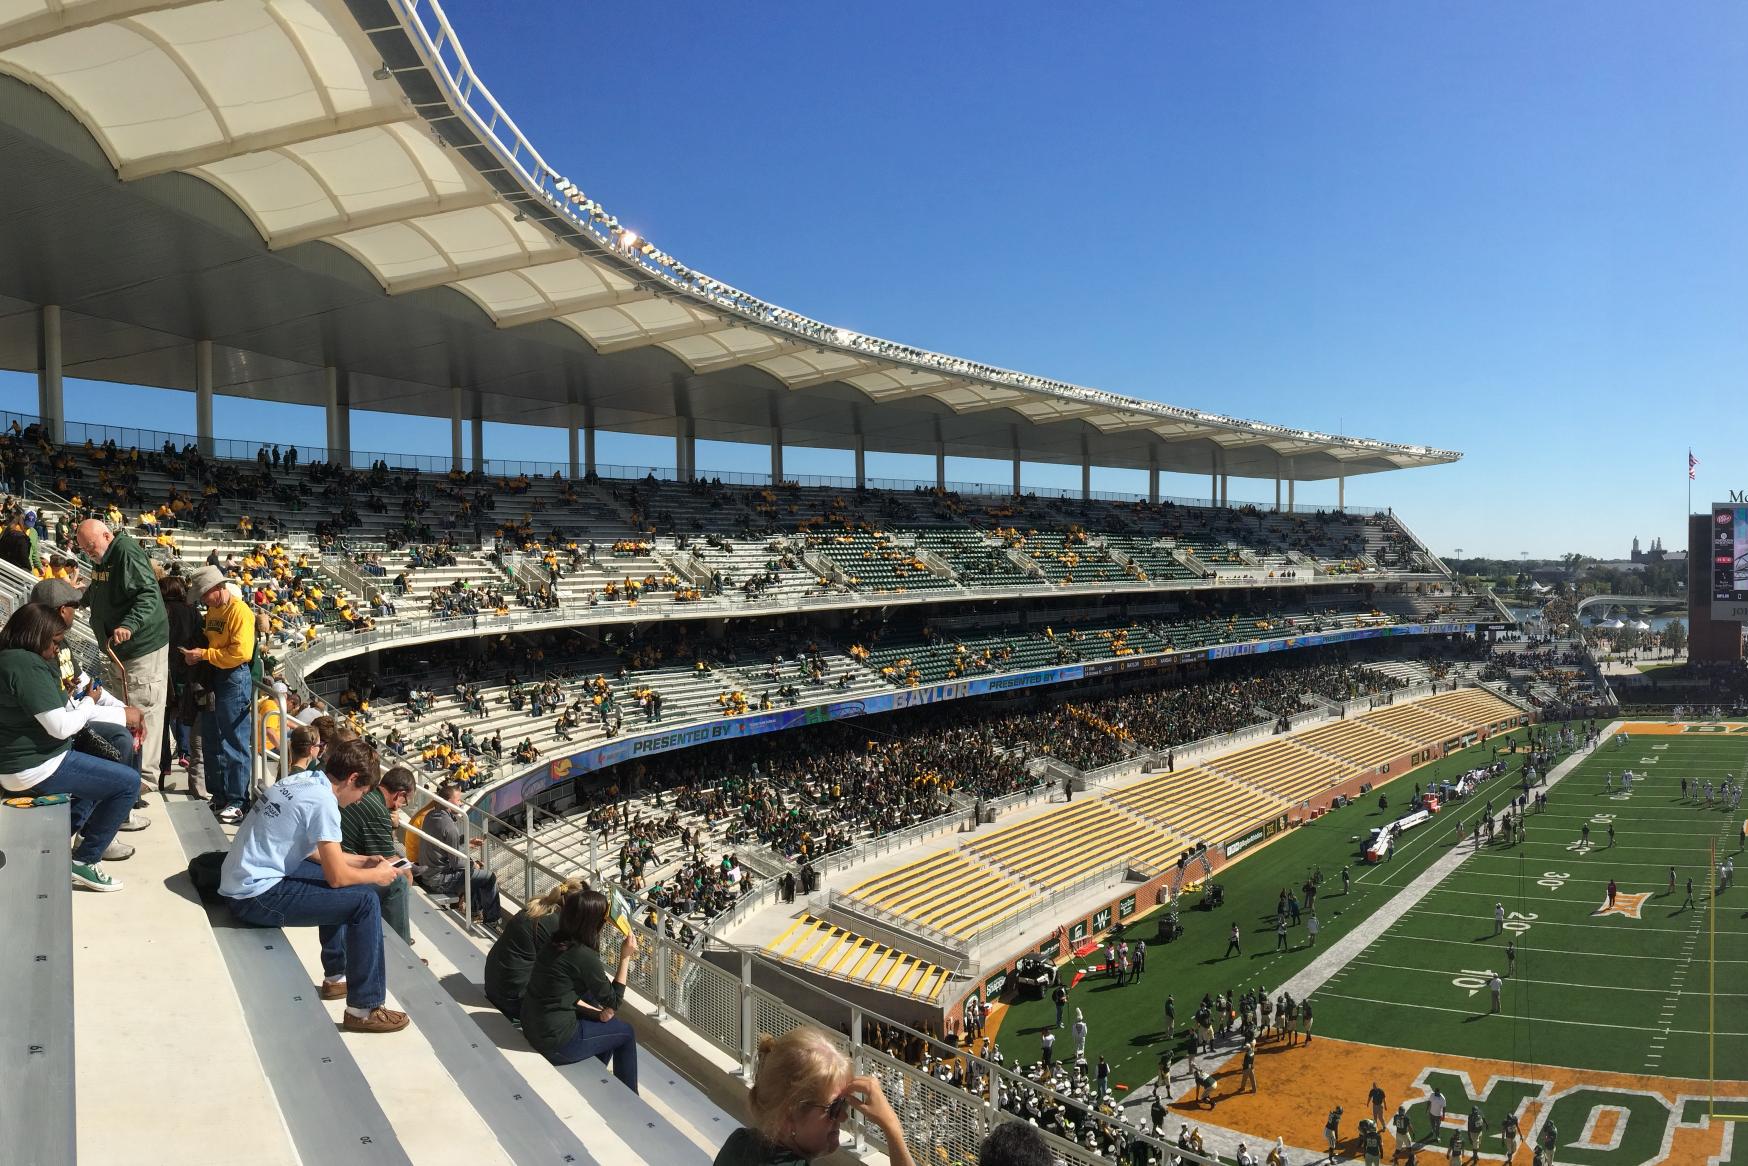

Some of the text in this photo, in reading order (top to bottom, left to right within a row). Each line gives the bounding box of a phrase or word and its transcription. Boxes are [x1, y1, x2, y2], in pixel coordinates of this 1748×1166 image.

[1120, 662, 1125, 671] 0
[1173, 655, 1178, 663] 0
[989, 671, 1056, 691] PRESENTED BY
[893, 682, 969, 709] BAYLOR
[633, 724, 731, 754] PRESENTED BY
[279, 787, 294, 800] 2014
[1537, 871, 1570, 887] 30
[1502, 911, 1539, 931] 20
[1452, 969, 1498, 989] 10
[359, 1136, 373, 1144] 20
